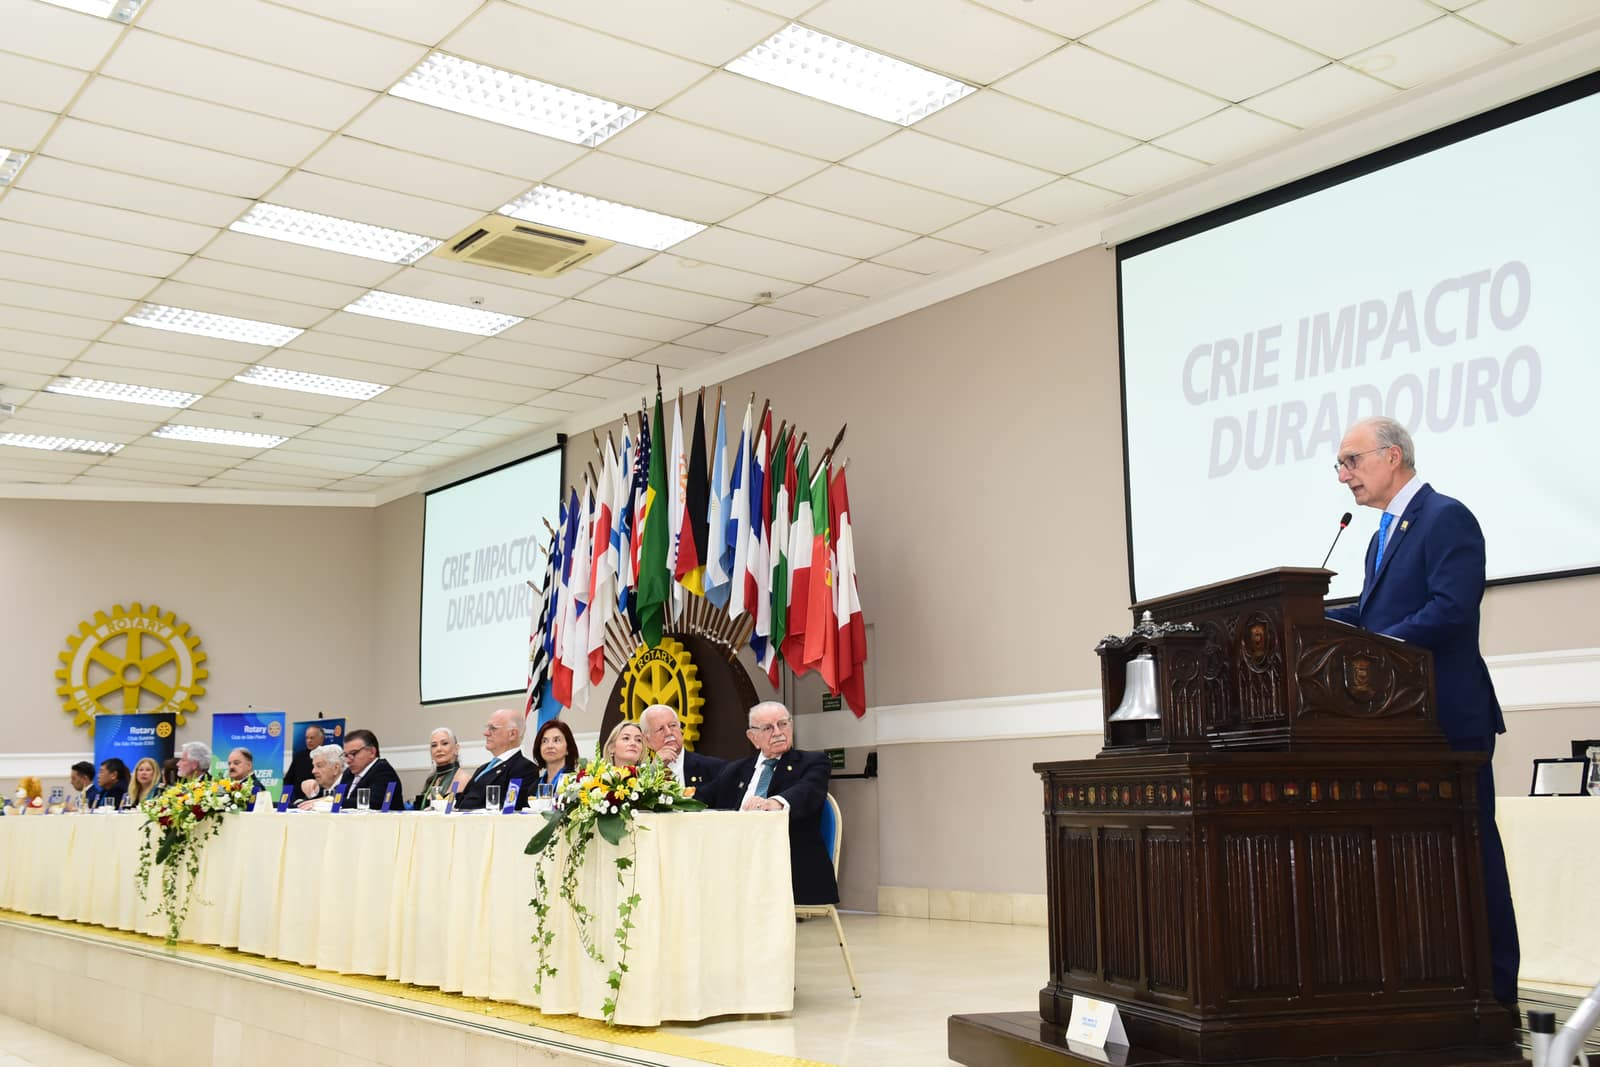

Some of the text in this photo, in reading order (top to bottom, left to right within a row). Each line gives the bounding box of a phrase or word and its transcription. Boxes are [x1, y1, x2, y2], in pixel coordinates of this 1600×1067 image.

[1182, 260, 1532, 406] CRIE IMPACTO
[1207, 345, 1543, 479] DURADOURO
[441, 534, 538, 592] CRIE IMPACTO
[108, 617, 167, 633] ROTARY
[637, 649, 676, 669] ROTARY
[130, 726, 155, 735] Rotary
[244, 725, 267, 733] Rotary
